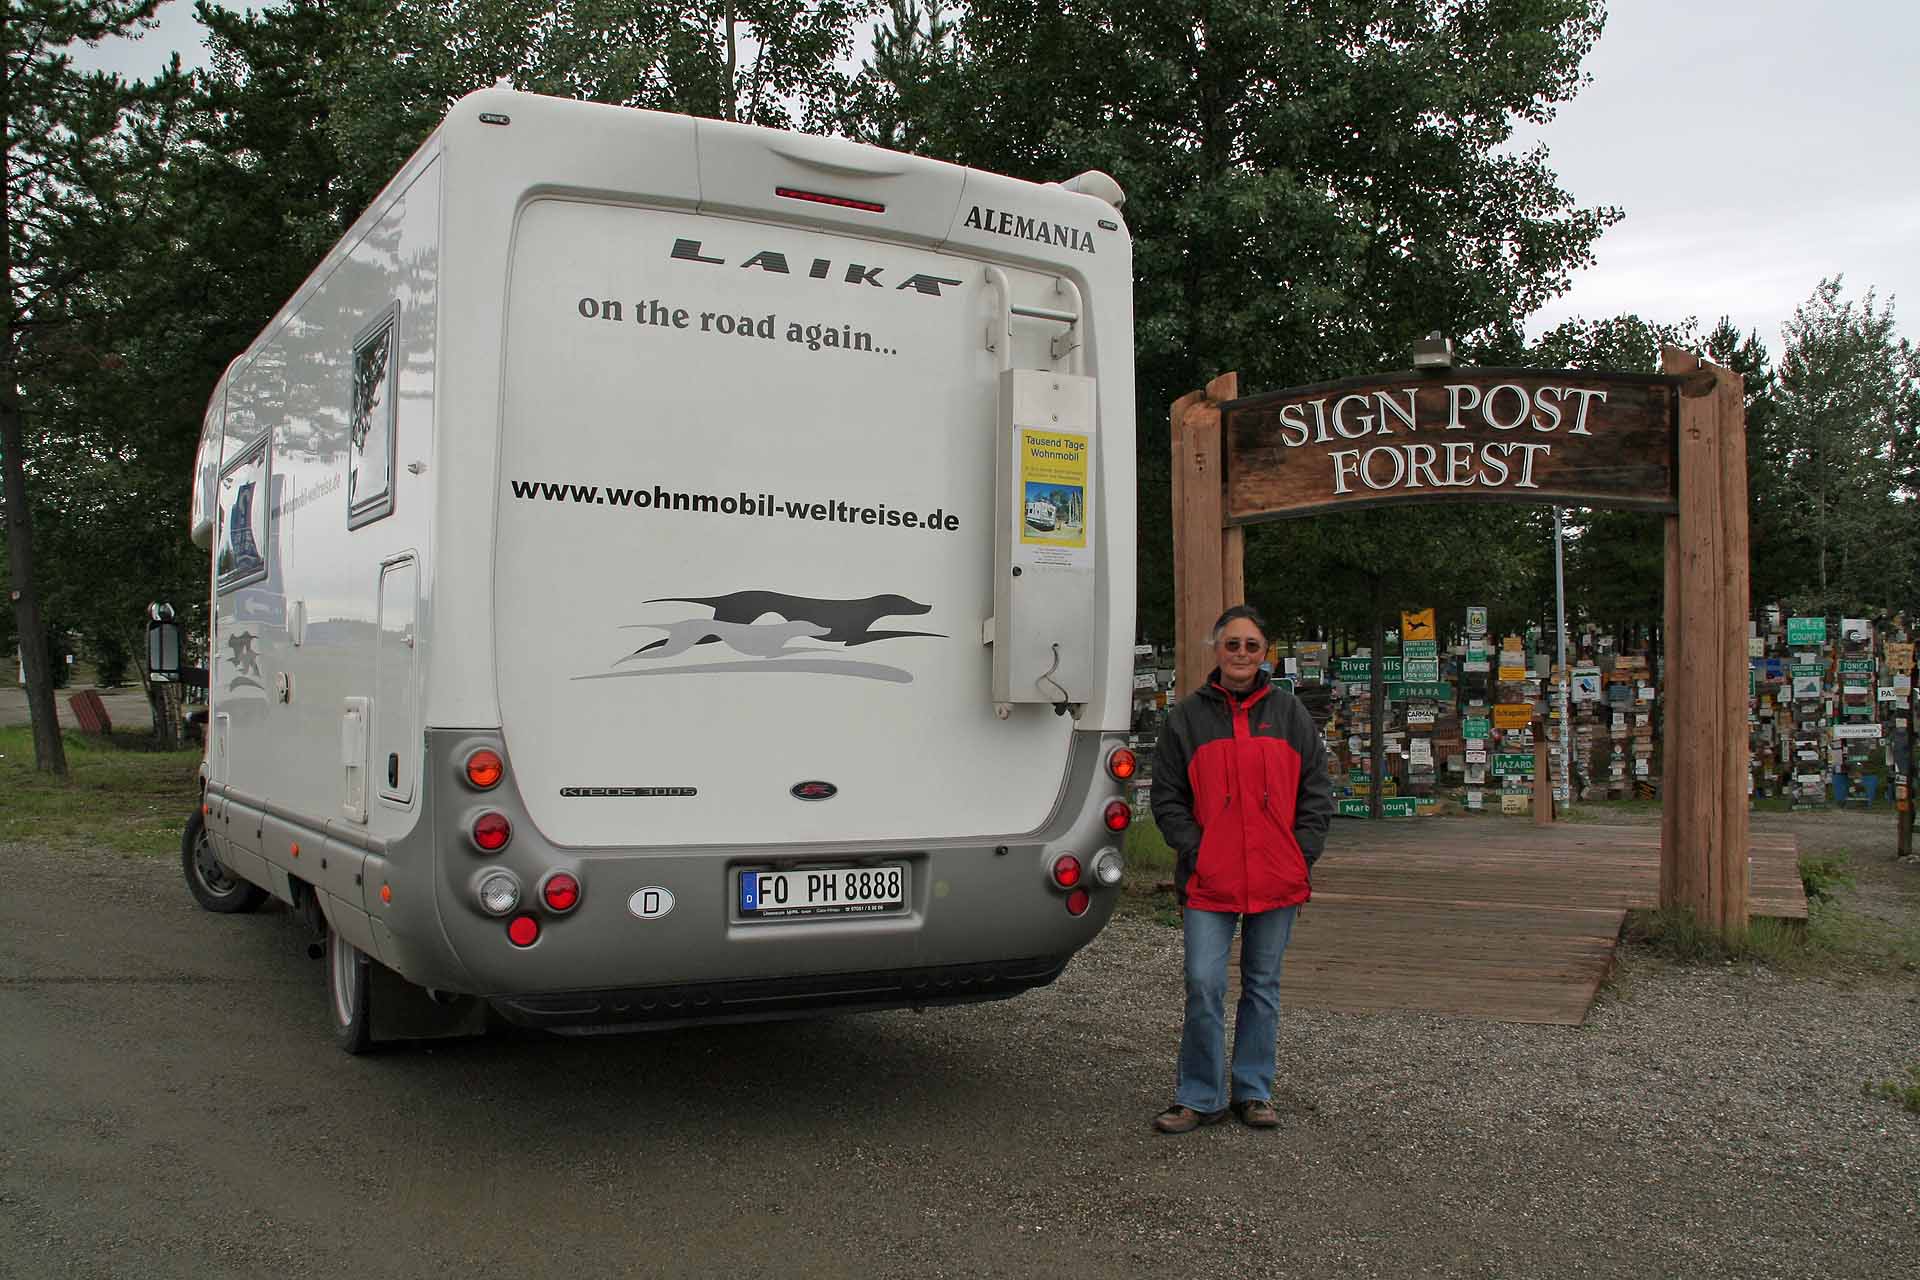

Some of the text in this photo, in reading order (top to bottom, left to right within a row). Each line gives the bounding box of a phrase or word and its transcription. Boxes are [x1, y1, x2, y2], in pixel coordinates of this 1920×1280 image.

[963, 205, 1097, 255] ALEMANIA
[670, 238, 964, 297] LAIKA
[579, 296, 898, 356] on the road again...
[1278, 383, 1608, 448] SIGN POST
[1025, 435, 1085, 452] Tausend Tage
[1031, 447, 1080, 463] Wohnmobil
[1328, 441, 1551, 495] FOREST
[511, 480, 960, 534] www.wohnmobil-weltreise.de
[1341, 660, 1370, 672] River
[643, 892, 660, 914] D
[758, 871, 900, 905] FO PH 8888
